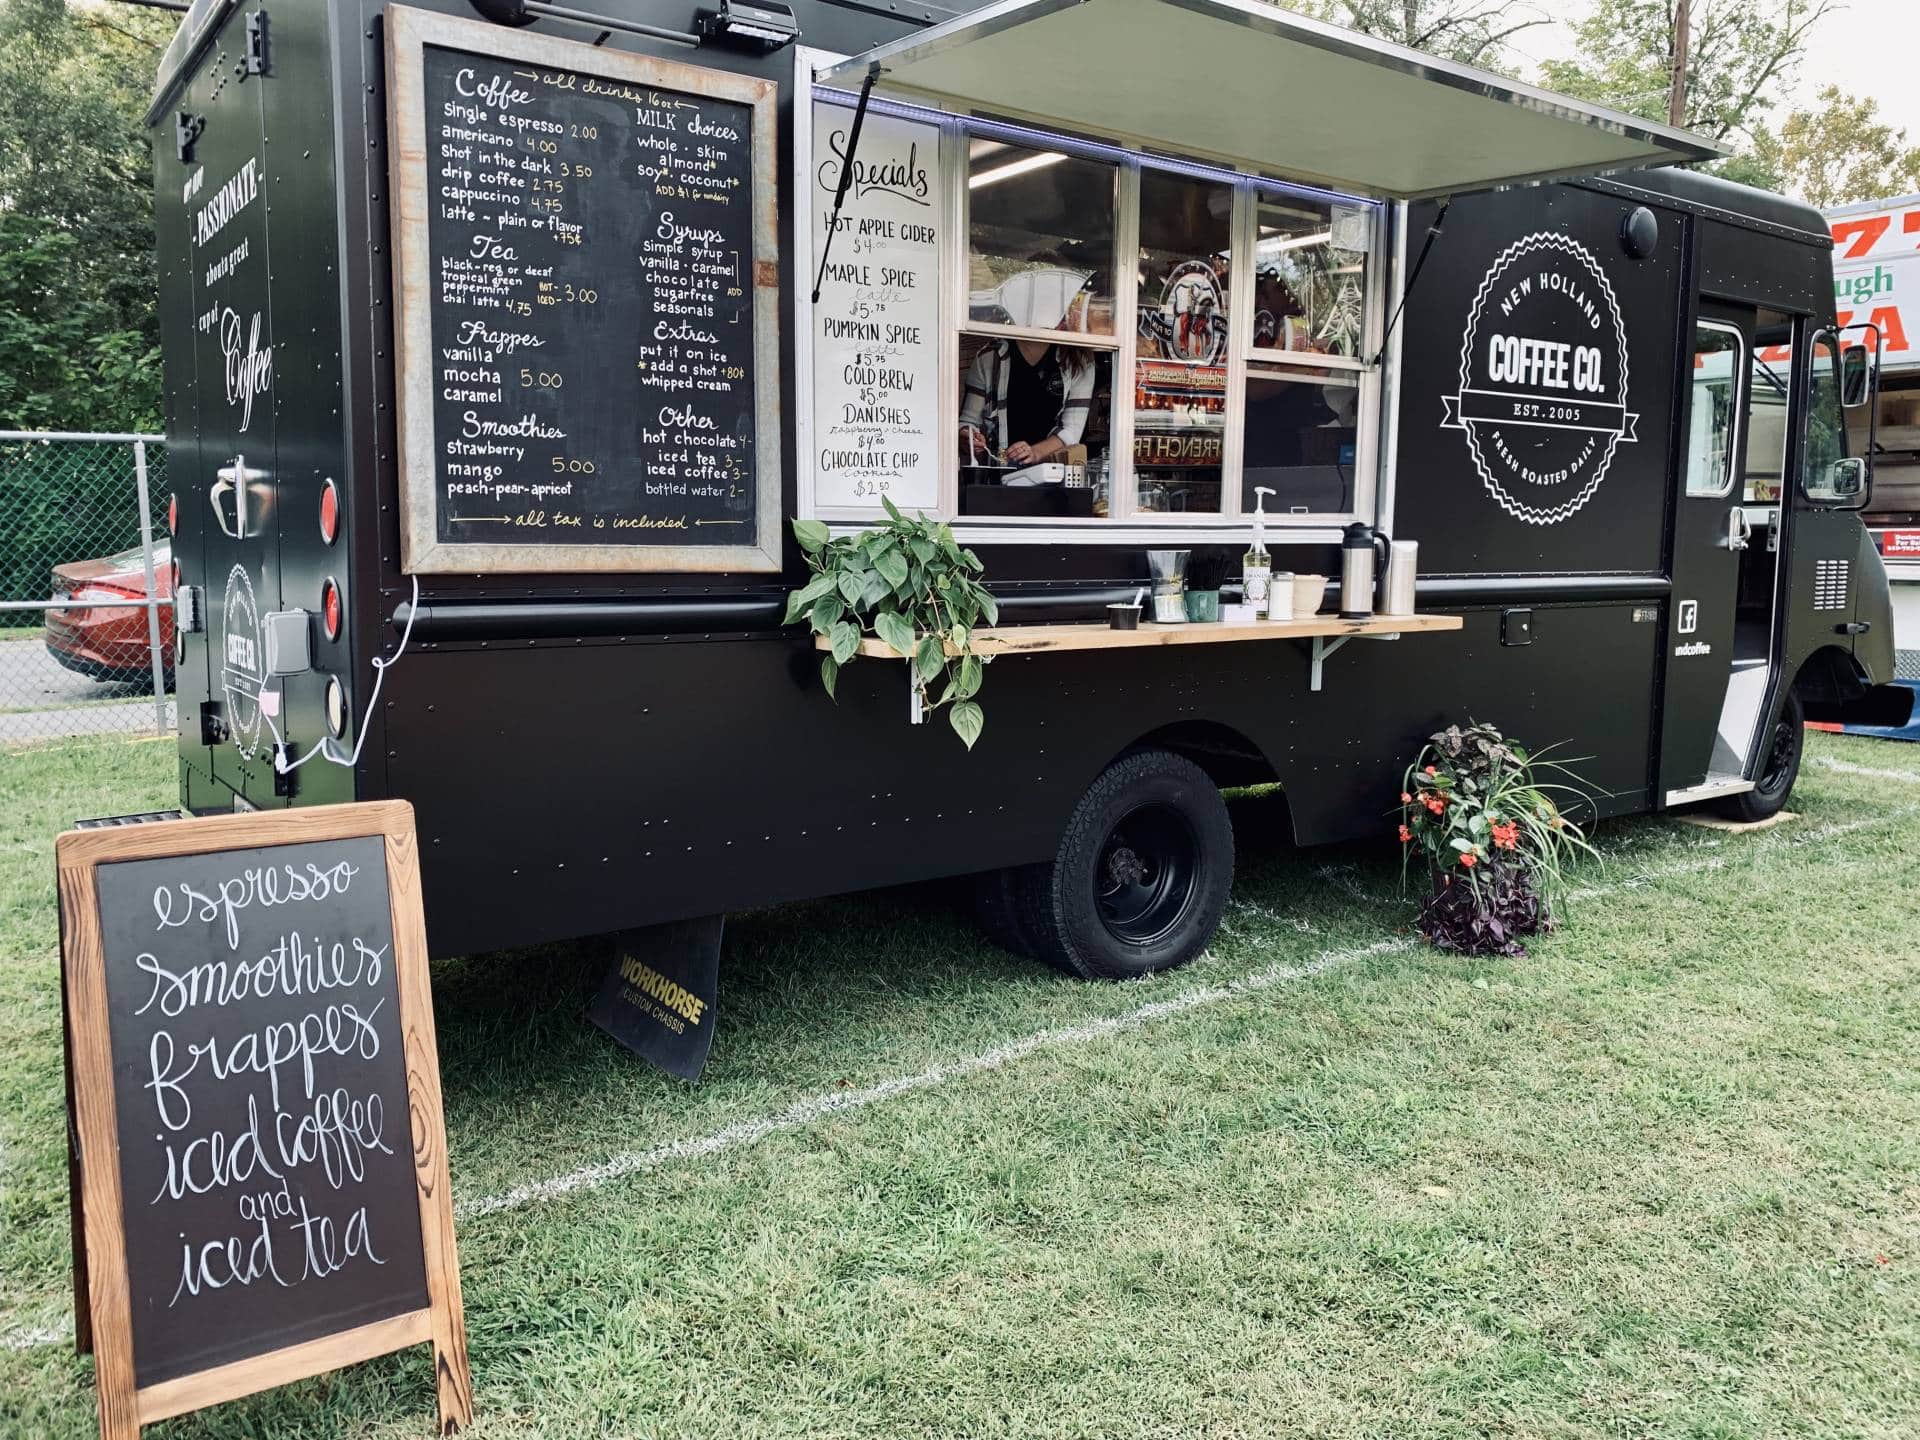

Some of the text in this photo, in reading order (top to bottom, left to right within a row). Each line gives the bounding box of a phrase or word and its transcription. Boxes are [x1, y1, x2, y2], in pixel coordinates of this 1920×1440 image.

[455, 68, 537, 110] Coffee
[543, 73, 577, 90] all
[582, 79, 643, 104] drinks
[648, 91, 660, 107] 16
[498, 113, 564, 133] espresso
[570, 124, 598, 140] 2.00
[636, 108, 740, 141] MILK choices
[441, 124, 557, 154] americano 4.00
[637, 133, 727, 161] whole skim
[441, 161, 564, 193] drip coffee 2.75
[478, 151, 491, 164] in
[493, 149, 516, 169] the
[521, 156, 552, 175] dark
[560, 162, 593, 178] 3.50
[818, 130, 928, 200] Specials
[197, 157, 257, 248] PASSIONATE
[441, 186, 563, 213] cappuccino 4.75
[655, 184, 675, 197] ADD
[441, 203, 583, 233] latte plain or flavor
[657, 211, 726, 249] Syrups
[824, 211, 936, 245] HOT APPLE CIDER
[229, 236, 249, 277] great
[469, 235, 519, 261] Tea
[691, 246, 723, 263] syrup
[441, 270, 523, 288] tropical green
[507, 266, 519, 275] or
[525, 264, 553, 277] decaf
[639, 255, 734, 277] vanilla caramel
[824, 262, 917, 288] MAPLE SPICE
[442, 282, 510, 296] peppermint
[565, 283, 598, 304] 3.00
[645, 270, 719, 290] chocolate
[727, 287, 743, 297] ADD
[442, 293, 533, 316] chai latte 4.75
[1500, 272, 1601, 329] NEW HOLLAND
[456, 320, 547, 354] Frappes
[653, 319, 720, 344] Extras
[824, 317, 922, 345] PUMPKIN SPICE
[442, 347, 493, 363] vanilla
[640, 344, 728, 363] put it on ice
[1488, 333, 1606, 393] COFFEE CO.
[220, 306, 272, 433] Coffee
[443, 367, 563, 389] mocha 5.00
[650, 360, 674, 373] add
[679, 363, 688, 373] a
[693, 363, 717, 377] shot
[844, 364, 915, 392] COLD BREW
[443, 387, 502, 403] caramel
[641, 373, 731, 392] whipped cream
[462, 410, 567, 439] Smoothies
[658, 403, 719, 430] Other
[842, 402, 912, 425] DANISHES
[642, 427, 667, 444] hot
[674, 429, 737, 448] chocolate
[447, 456, 595, 482] mango 5.00
[647, 461, 676, 477] iced
[684, 465, 729, 480] coffee
[658, 449, 689, 463] iced
[695, 450, 717, 466] tea
[821, 448, 920, 472] CHOCOLATE CHIP
[1491, 430, 1596, 486] FRESH ROASTED DAILY
[447, 480, 573, 502] peach-pear-apricot
[645, 481, 687, 497] bottled
[691, 484, 725, 497] water
[515, 509, 689, 530] all tax is included
[153, 860, 360, 951] espresso
[134, 930, 389, 1017] smoothies
[619, 952, 705, 1026] WORKHORSE
[623, 987, 685, 1036] CUSTOM CHASSIS
[144, 996, 385, 1131] frappes
[150, 1087, 394, 1205] iced coffee
[238, 1178, 297, 1221] and
[168, 1195, 390, 1308] iced tea
